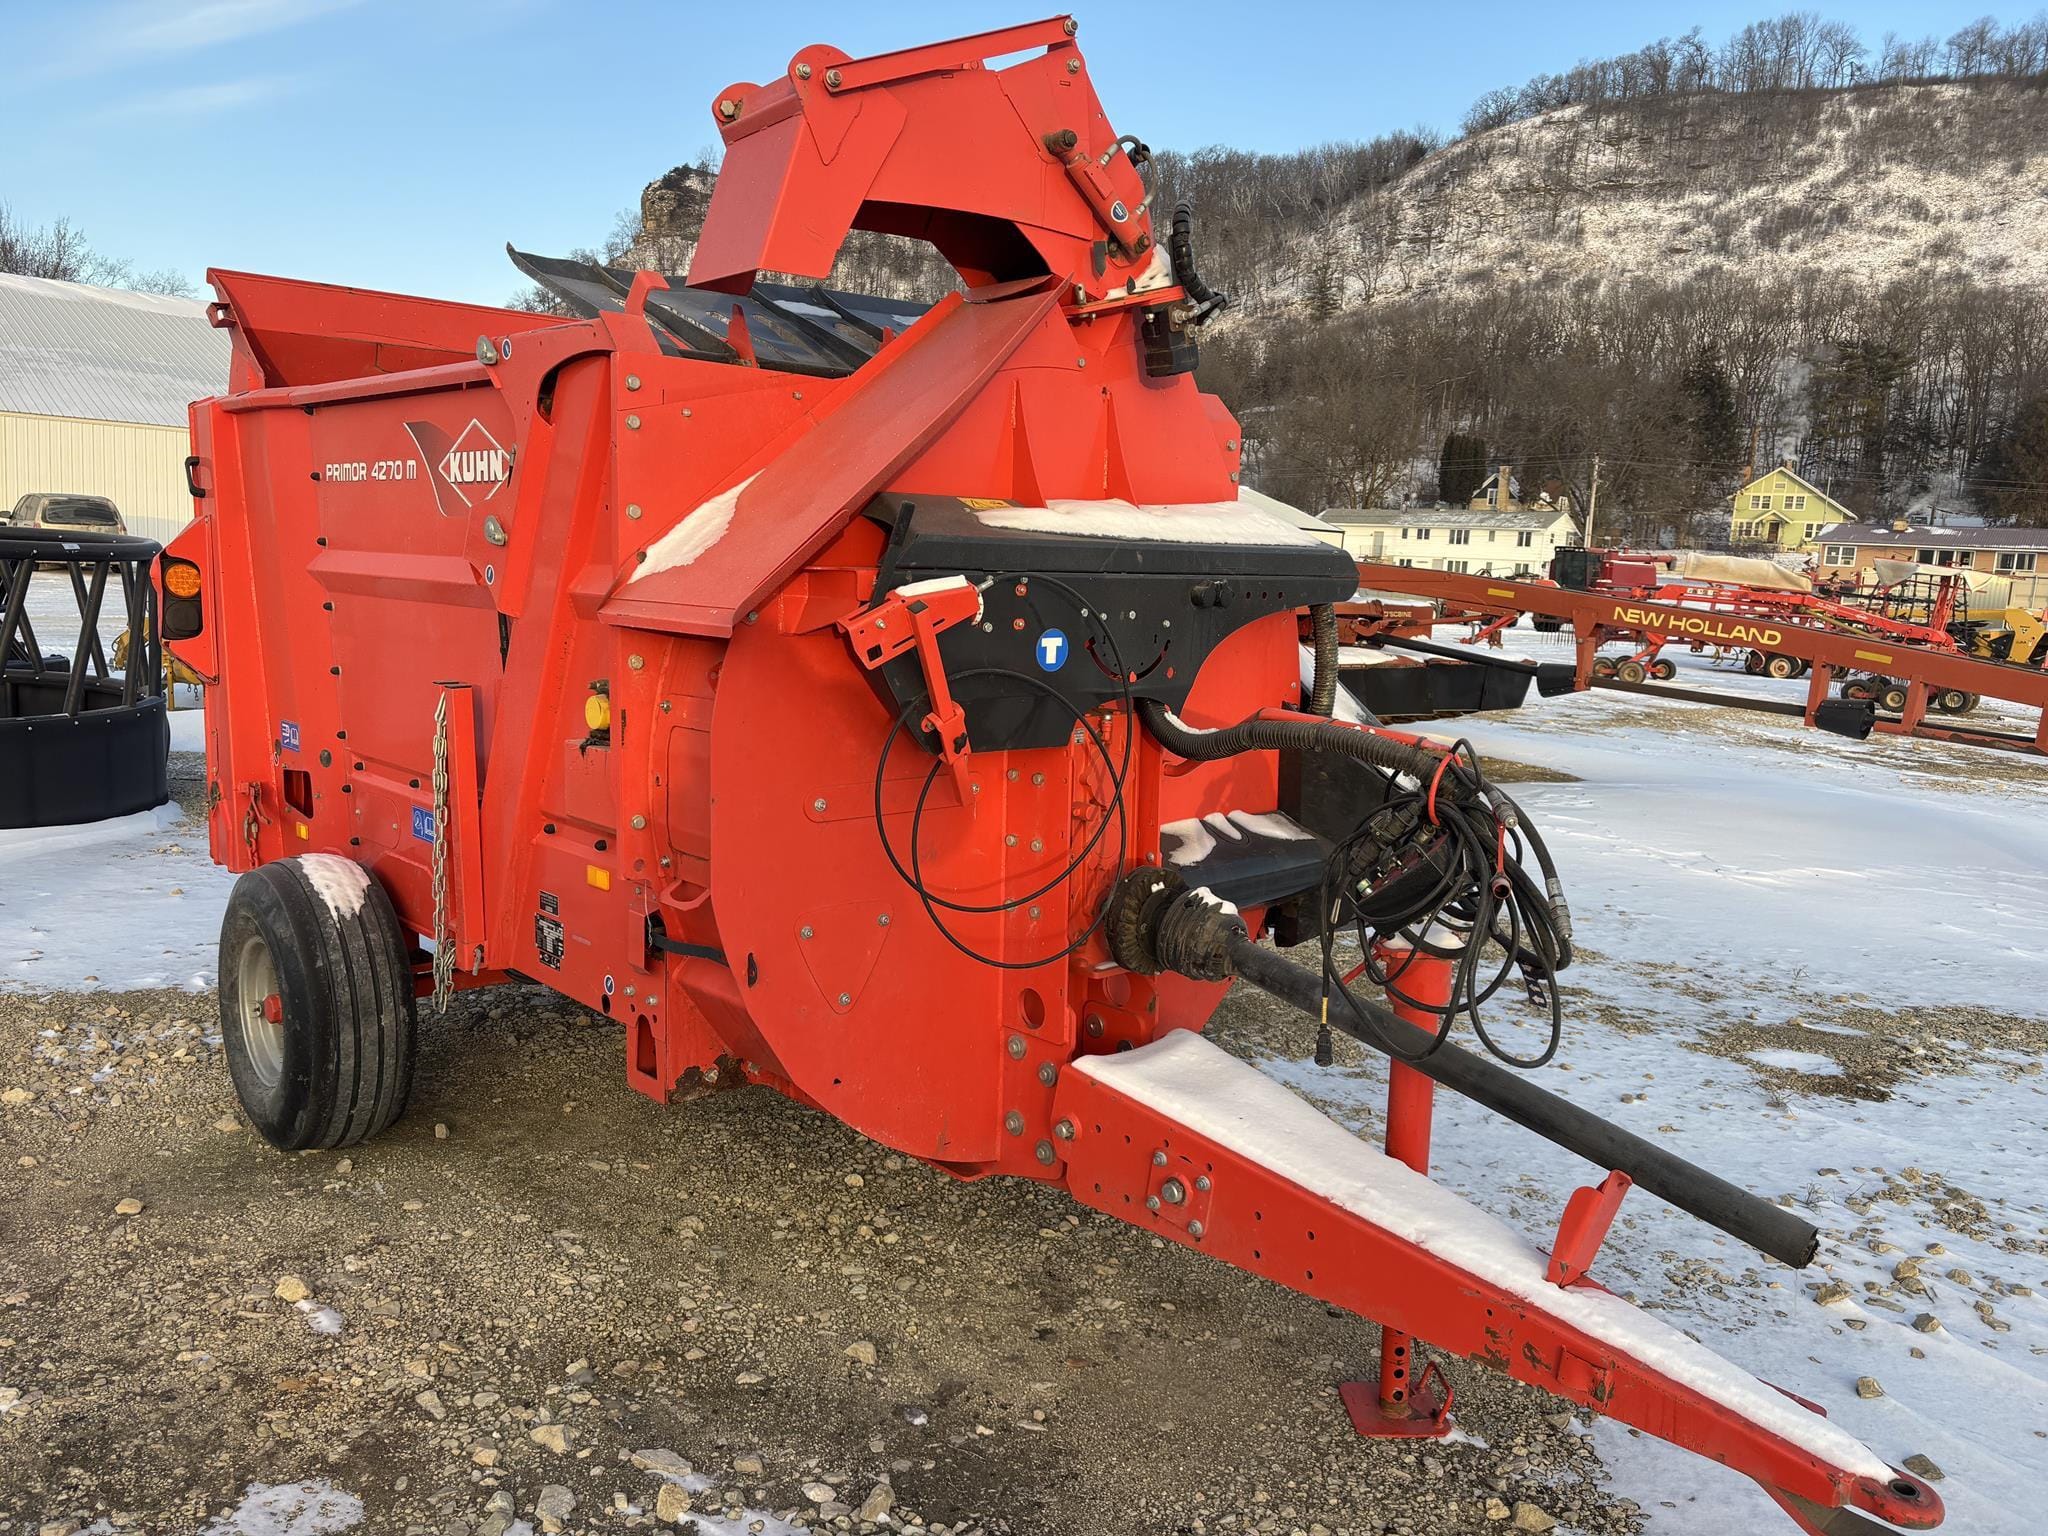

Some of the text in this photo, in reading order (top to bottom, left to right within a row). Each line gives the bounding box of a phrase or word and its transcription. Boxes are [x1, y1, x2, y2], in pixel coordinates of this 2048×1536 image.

[325, 463, 367, 482] PRIMOR
[371, 460, 403, 481] 4270
[450, 450, 503, 483] KUHN
[1613, 606, 1782, 646] NEW HOLLAND
[1041, 637, 1063, 665] T
